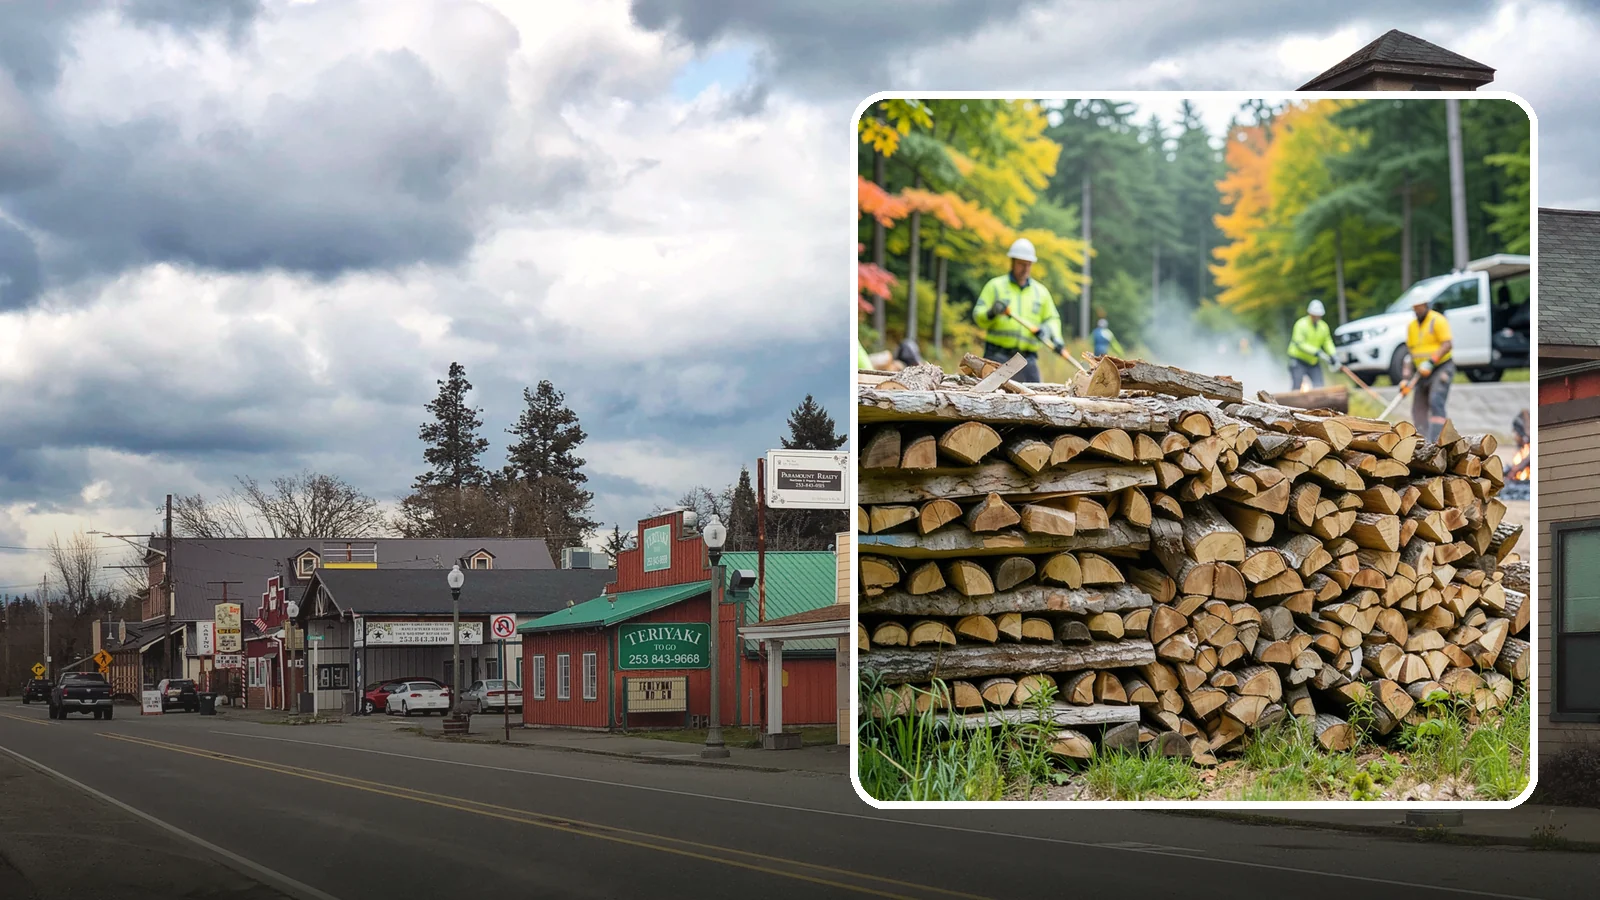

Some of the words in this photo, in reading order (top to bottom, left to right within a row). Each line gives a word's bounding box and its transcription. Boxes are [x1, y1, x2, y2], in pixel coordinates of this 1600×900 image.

[625, 628, 702, 646] TERIYAKI
[629, 654, 648, 664] 253
[652, 654, 700, 664] 843-9668
